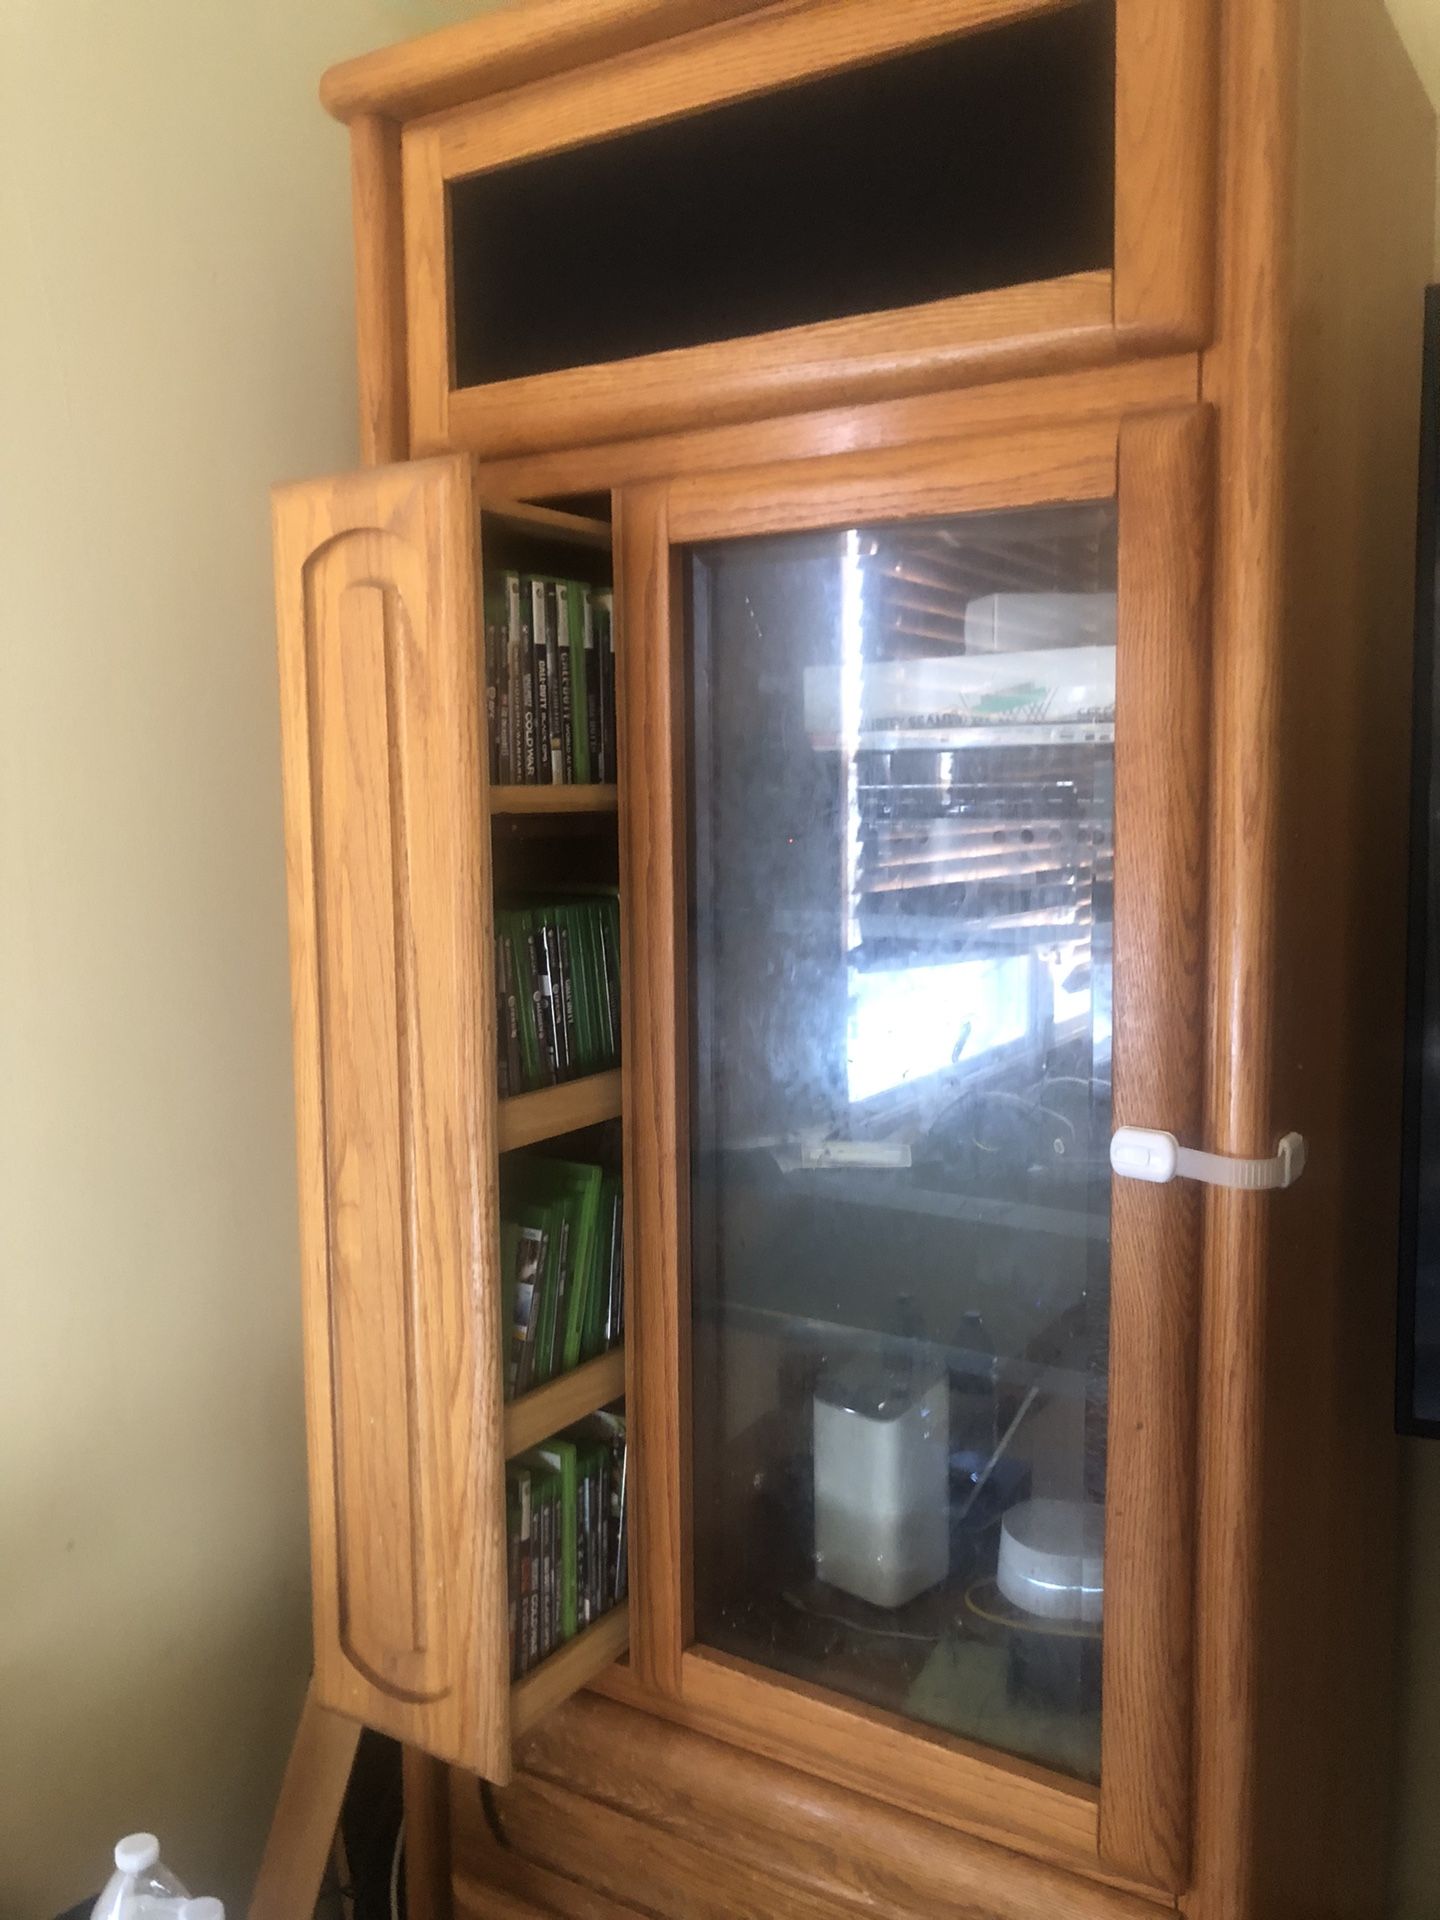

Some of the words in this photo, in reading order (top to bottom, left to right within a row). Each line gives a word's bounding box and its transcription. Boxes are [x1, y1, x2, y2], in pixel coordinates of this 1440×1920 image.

[539, 684, 547, 709] DUTY
[525, 711, 535, 748] COLD
[526, 748, 536, 776] WAR
